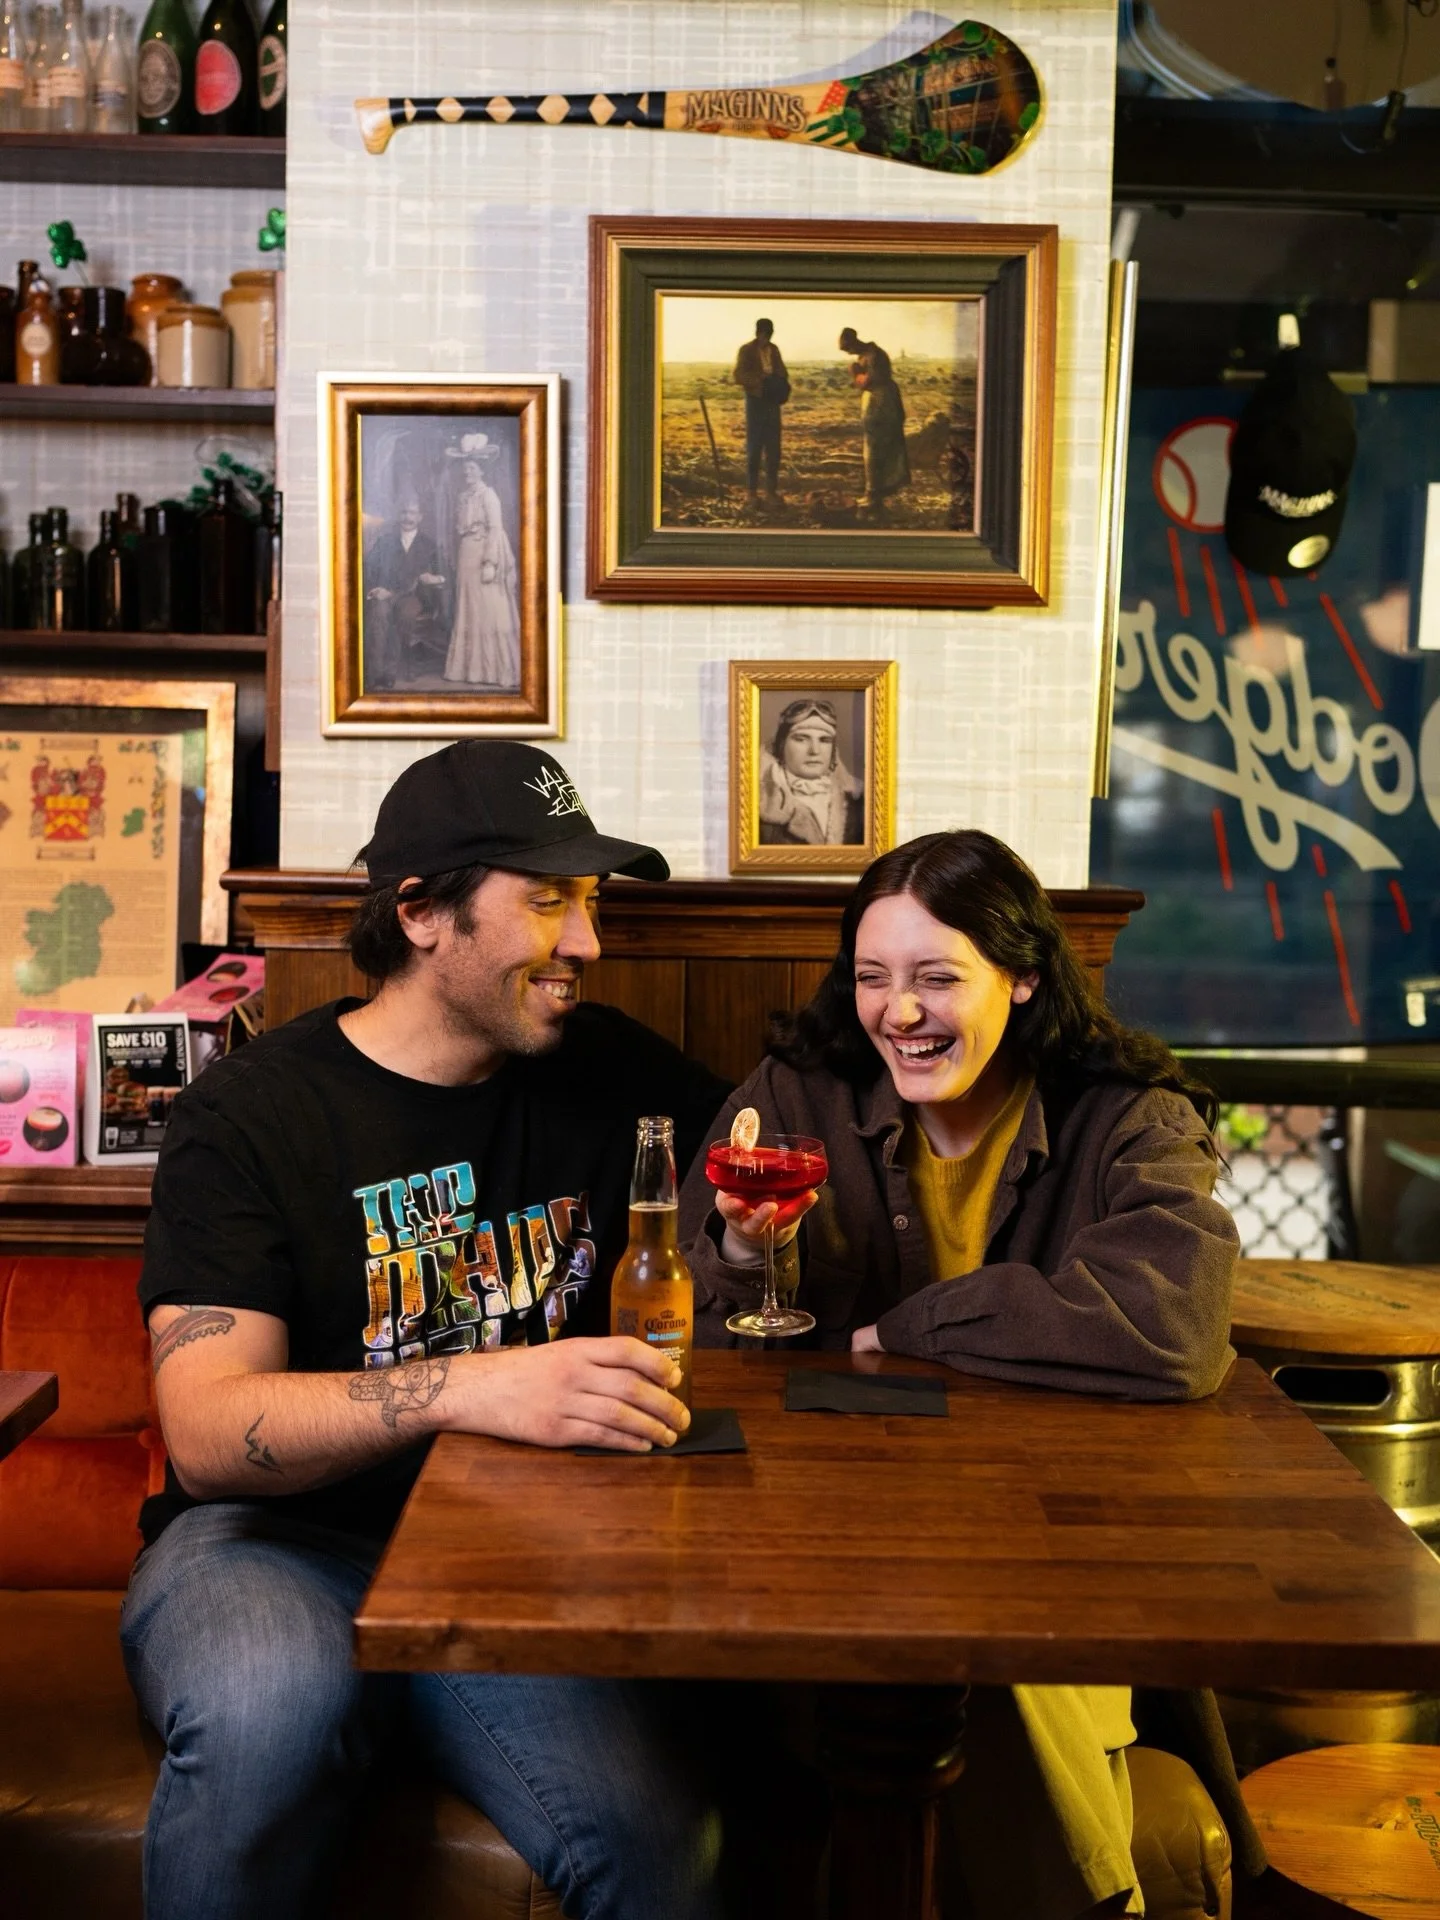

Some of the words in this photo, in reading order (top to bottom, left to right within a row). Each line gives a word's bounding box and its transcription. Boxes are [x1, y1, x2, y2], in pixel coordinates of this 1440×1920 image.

[684, 89, 808, 133] MAGINNS
[107, 1032, 140, 1048] SAVE
[142, 1031, 167, 1047] $10
[645, 1318, 686, 1331] Corona
